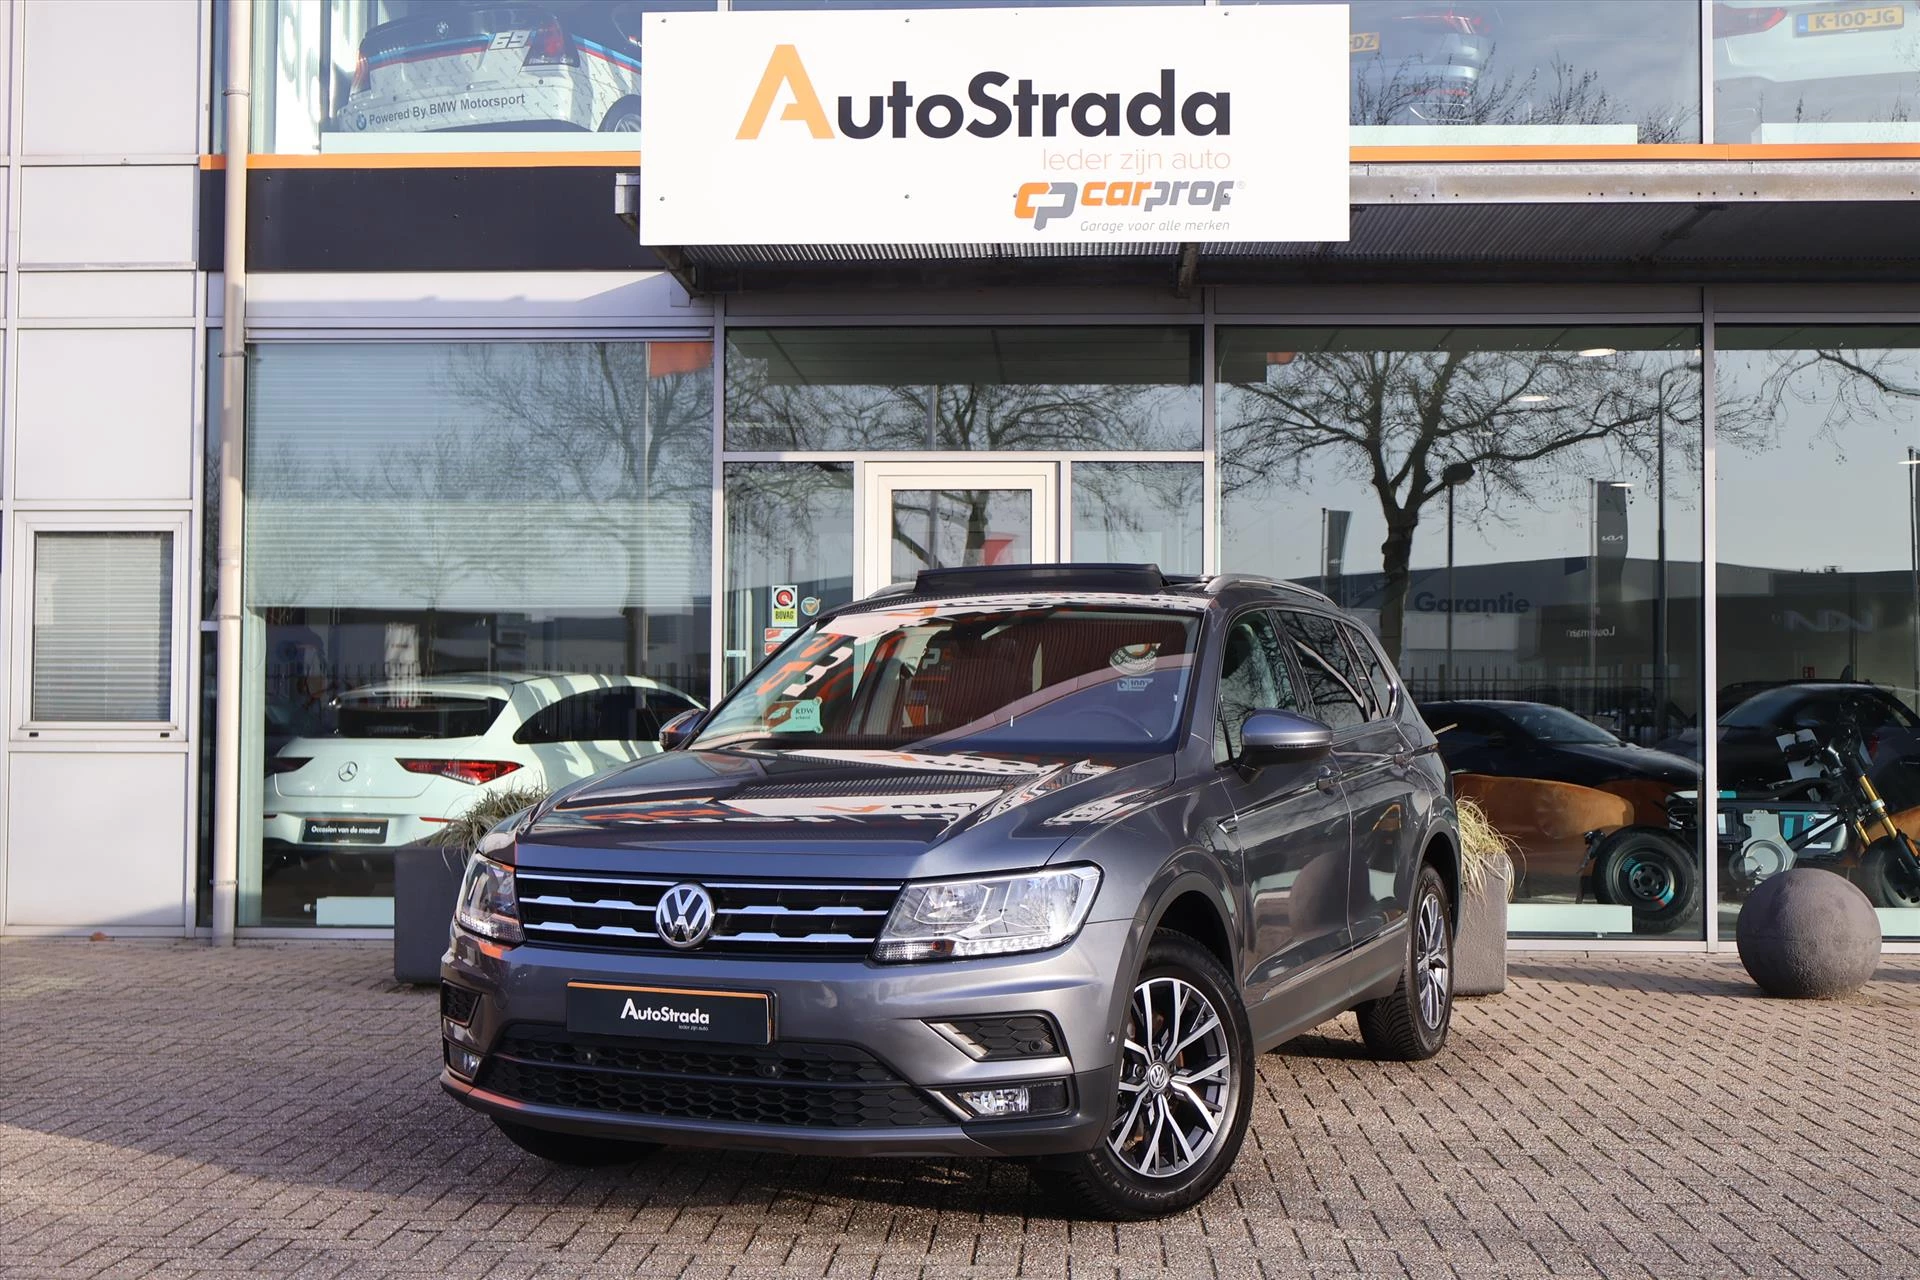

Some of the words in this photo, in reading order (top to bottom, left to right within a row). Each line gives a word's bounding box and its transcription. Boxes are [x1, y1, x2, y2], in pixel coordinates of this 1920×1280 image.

[1815, 9, 1895, 29] K-100-JG
[488, 31, 531, 50] 69
[735, 44, 1231, 140] AutoStrada
[369, 108, 410, 125] Powered
[412, 106, 426, 119] By
[429, 100, 457, 115] BMW
[460, 94, 525, 110] Motorsport
[1042, 148, 1113, 171] Ieder
[1120, 149, 1162, 175] zijn
[1171, 151, 1231, 171] auto
[1080, 220, 1124, 234] Garage
[1128, 222, 1155, 232] voor
[1158, 220, 1181, 232] alle
[1184, 220, 1230, 232] merken
[1413, 591, 1531, 613] Garantie
[311, 825, 337, 834] Occasion
[338, 826, 349, 834] van
[349, 825, 358, 834] de
[358, 826, 381, 834] maand
[620, 998, 710, 1025] AutoStrada
